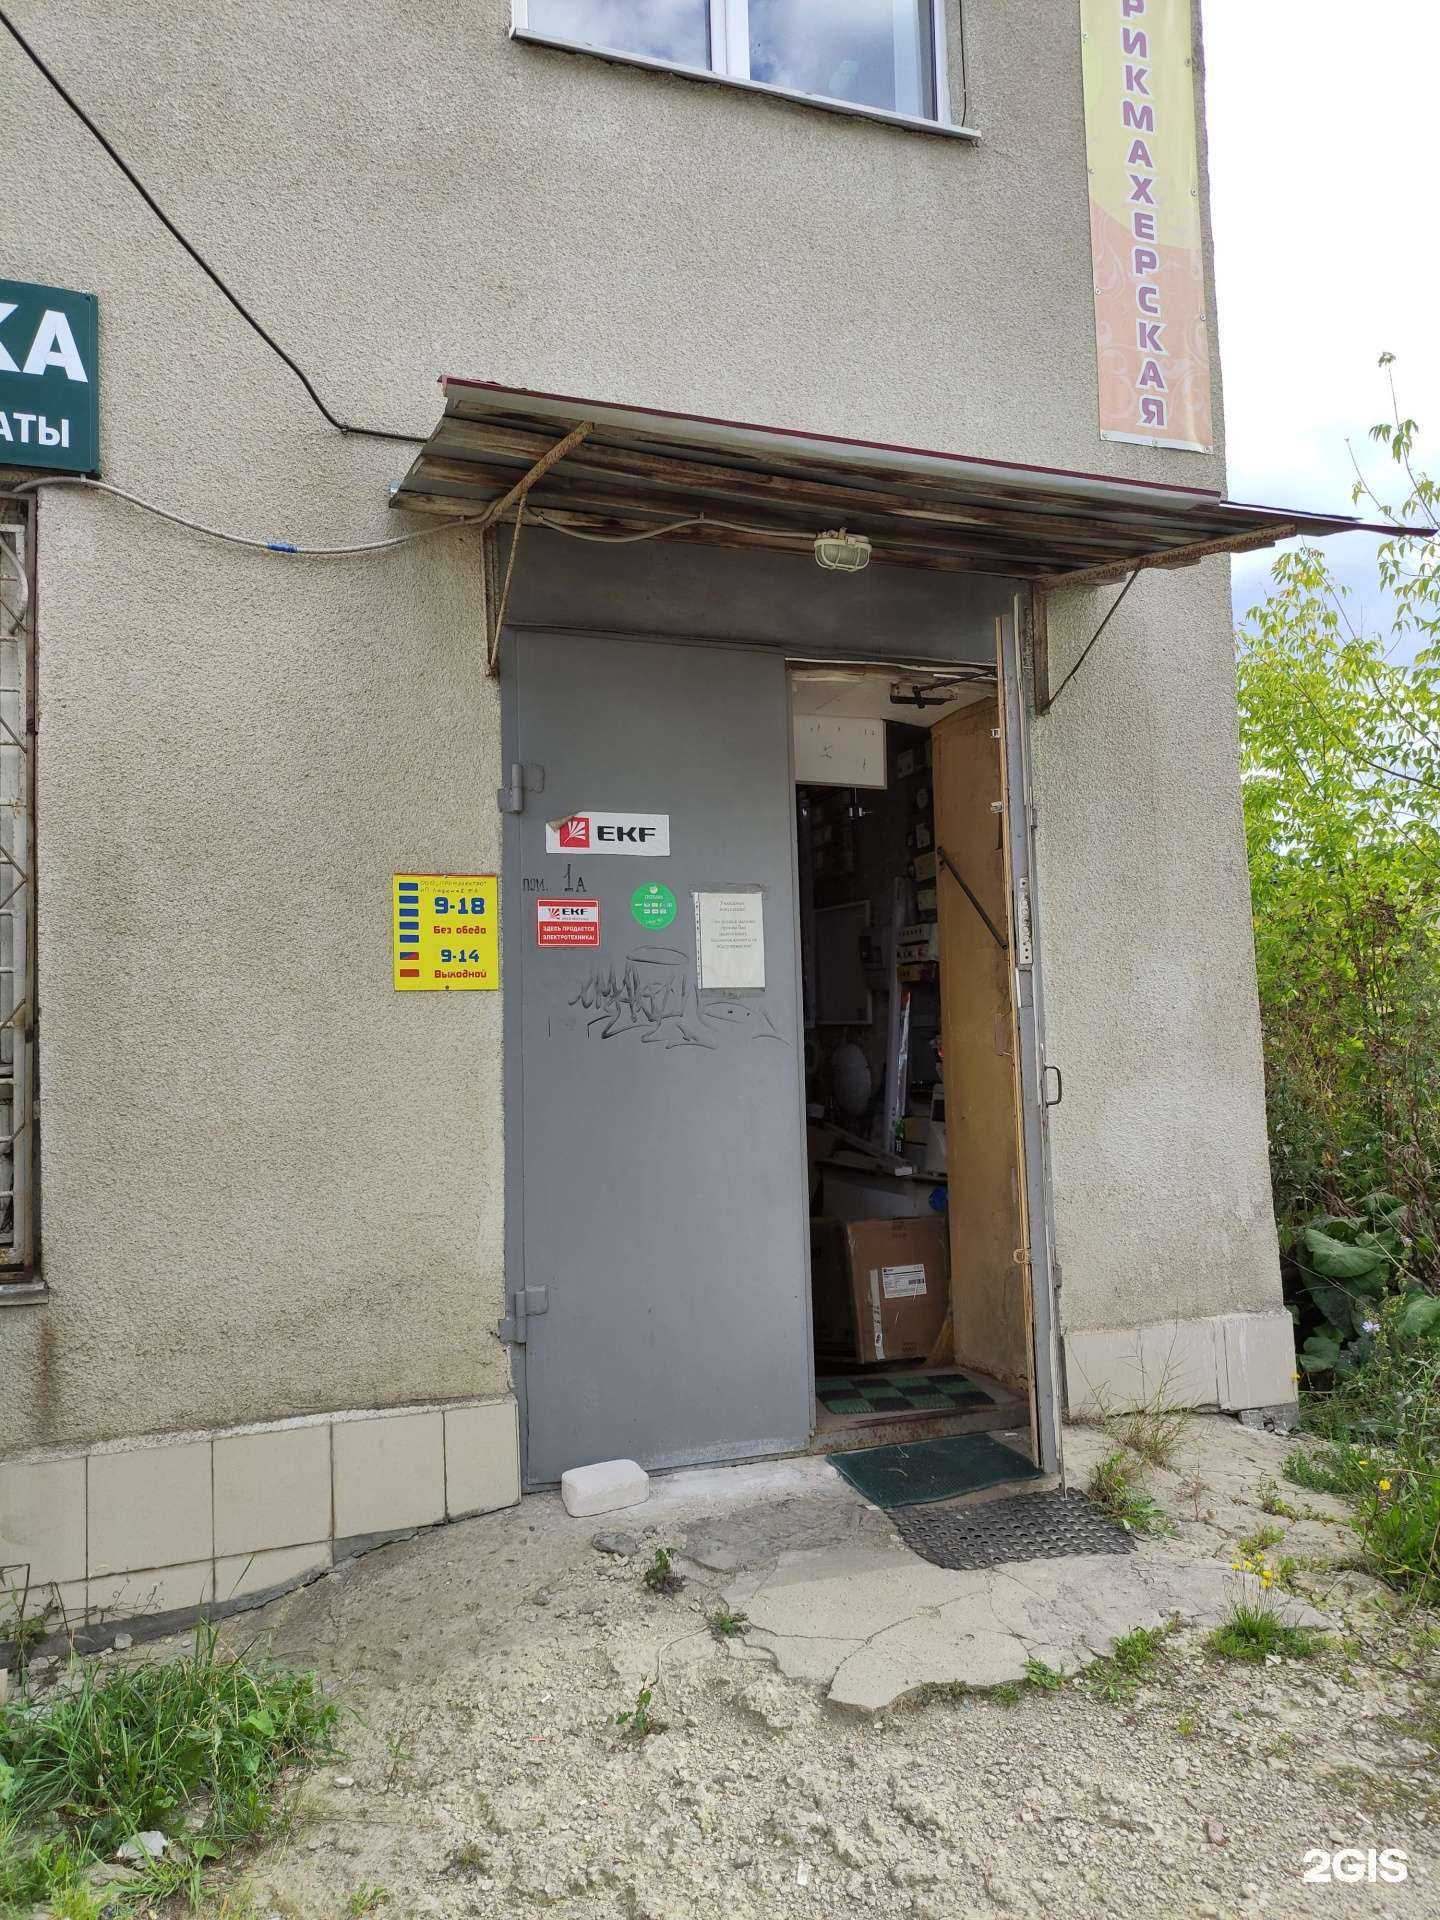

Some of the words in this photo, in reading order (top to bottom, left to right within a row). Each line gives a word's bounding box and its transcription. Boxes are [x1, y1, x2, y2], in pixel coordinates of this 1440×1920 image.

[597, 825, 657, 843] EKF
[434, 896, 485, 915] 9-18
[562, 908, 589, 916] EKF
[433, 925, 452, 934] Без
[440, 949, 480, 963] 9-14
[434, 969, 487, 979] Выходной
